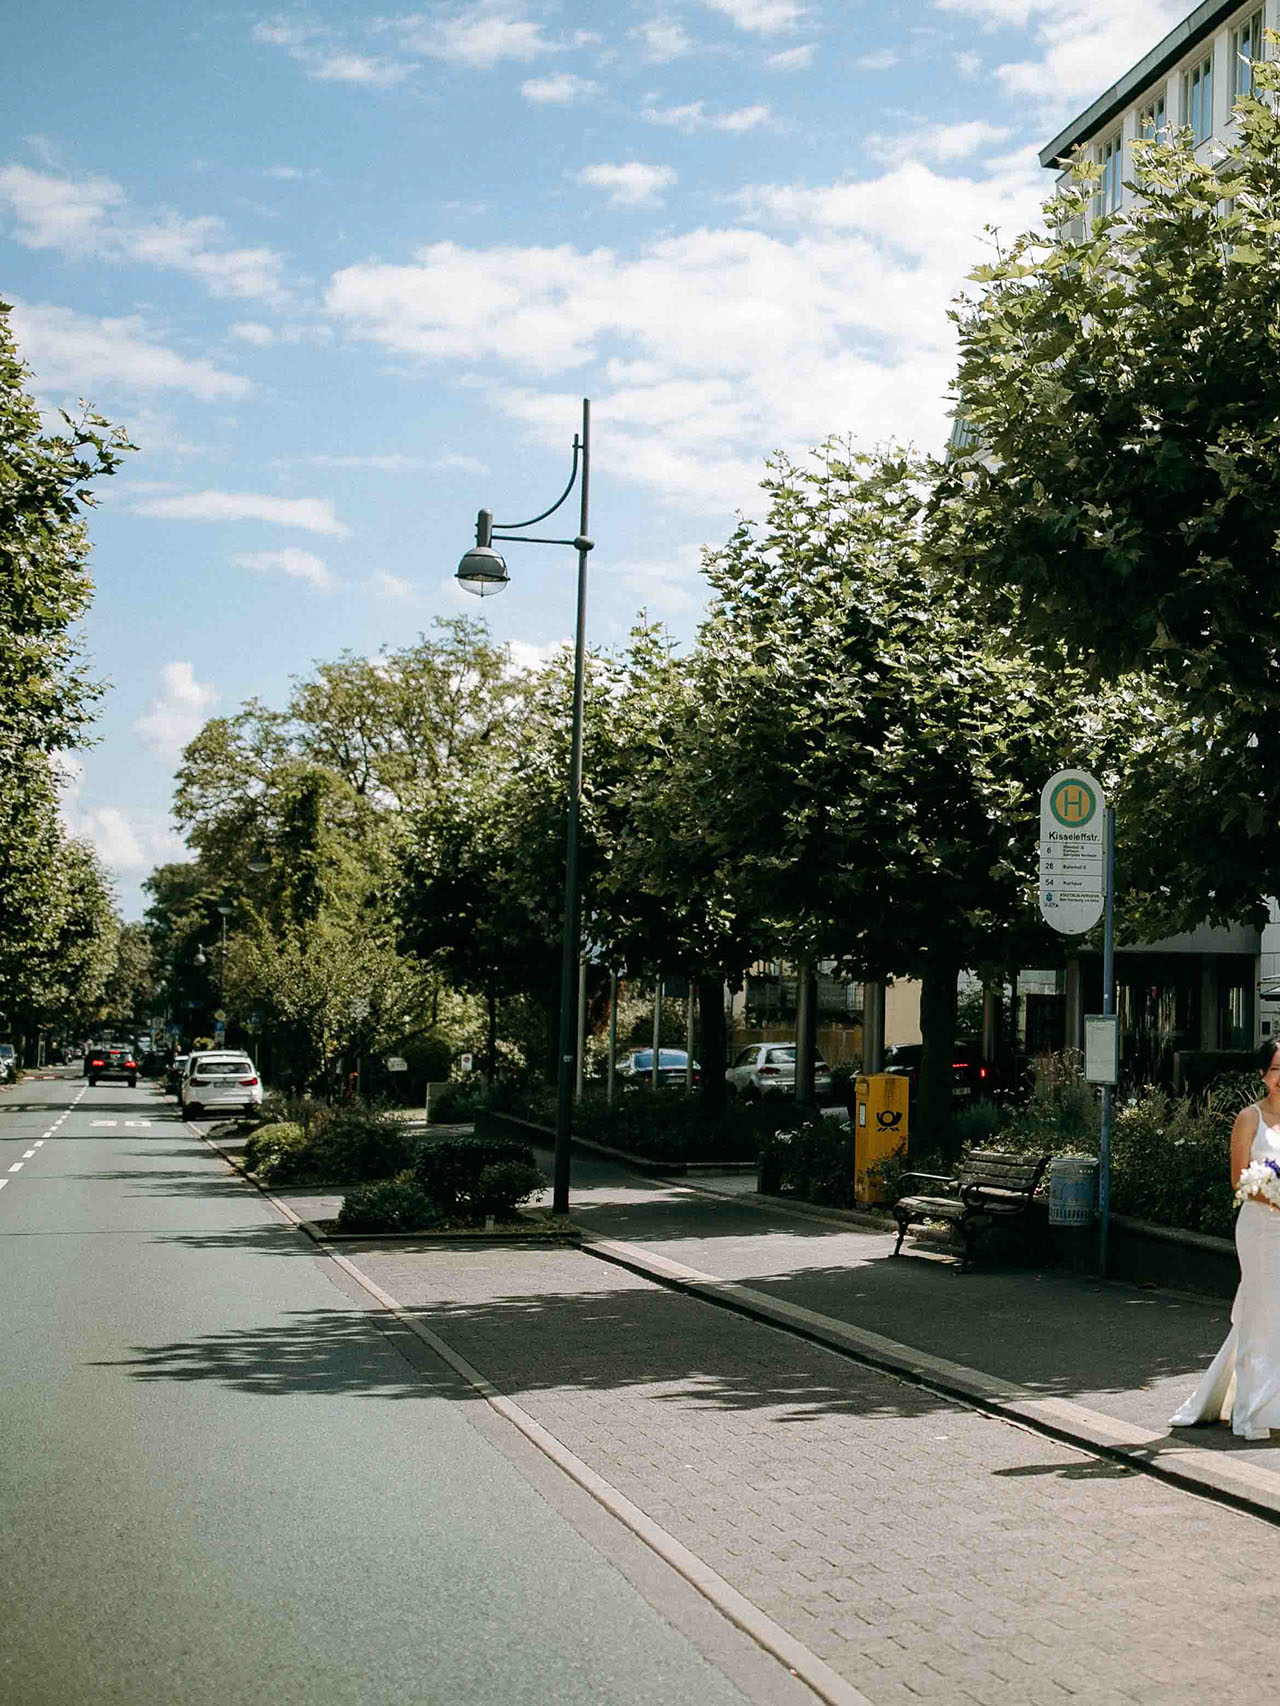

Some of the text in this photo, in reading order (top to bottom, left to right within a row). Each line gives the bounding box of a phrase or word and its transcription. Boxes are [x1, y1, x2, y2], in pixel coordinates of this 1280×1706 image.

[1063, 790, 1082, 817] H
[1049, 831, 1100, 842] Kisseleffstr.
[1046, 846, 1052, 854] 6
[1045, 878, 1054, 886] 54
